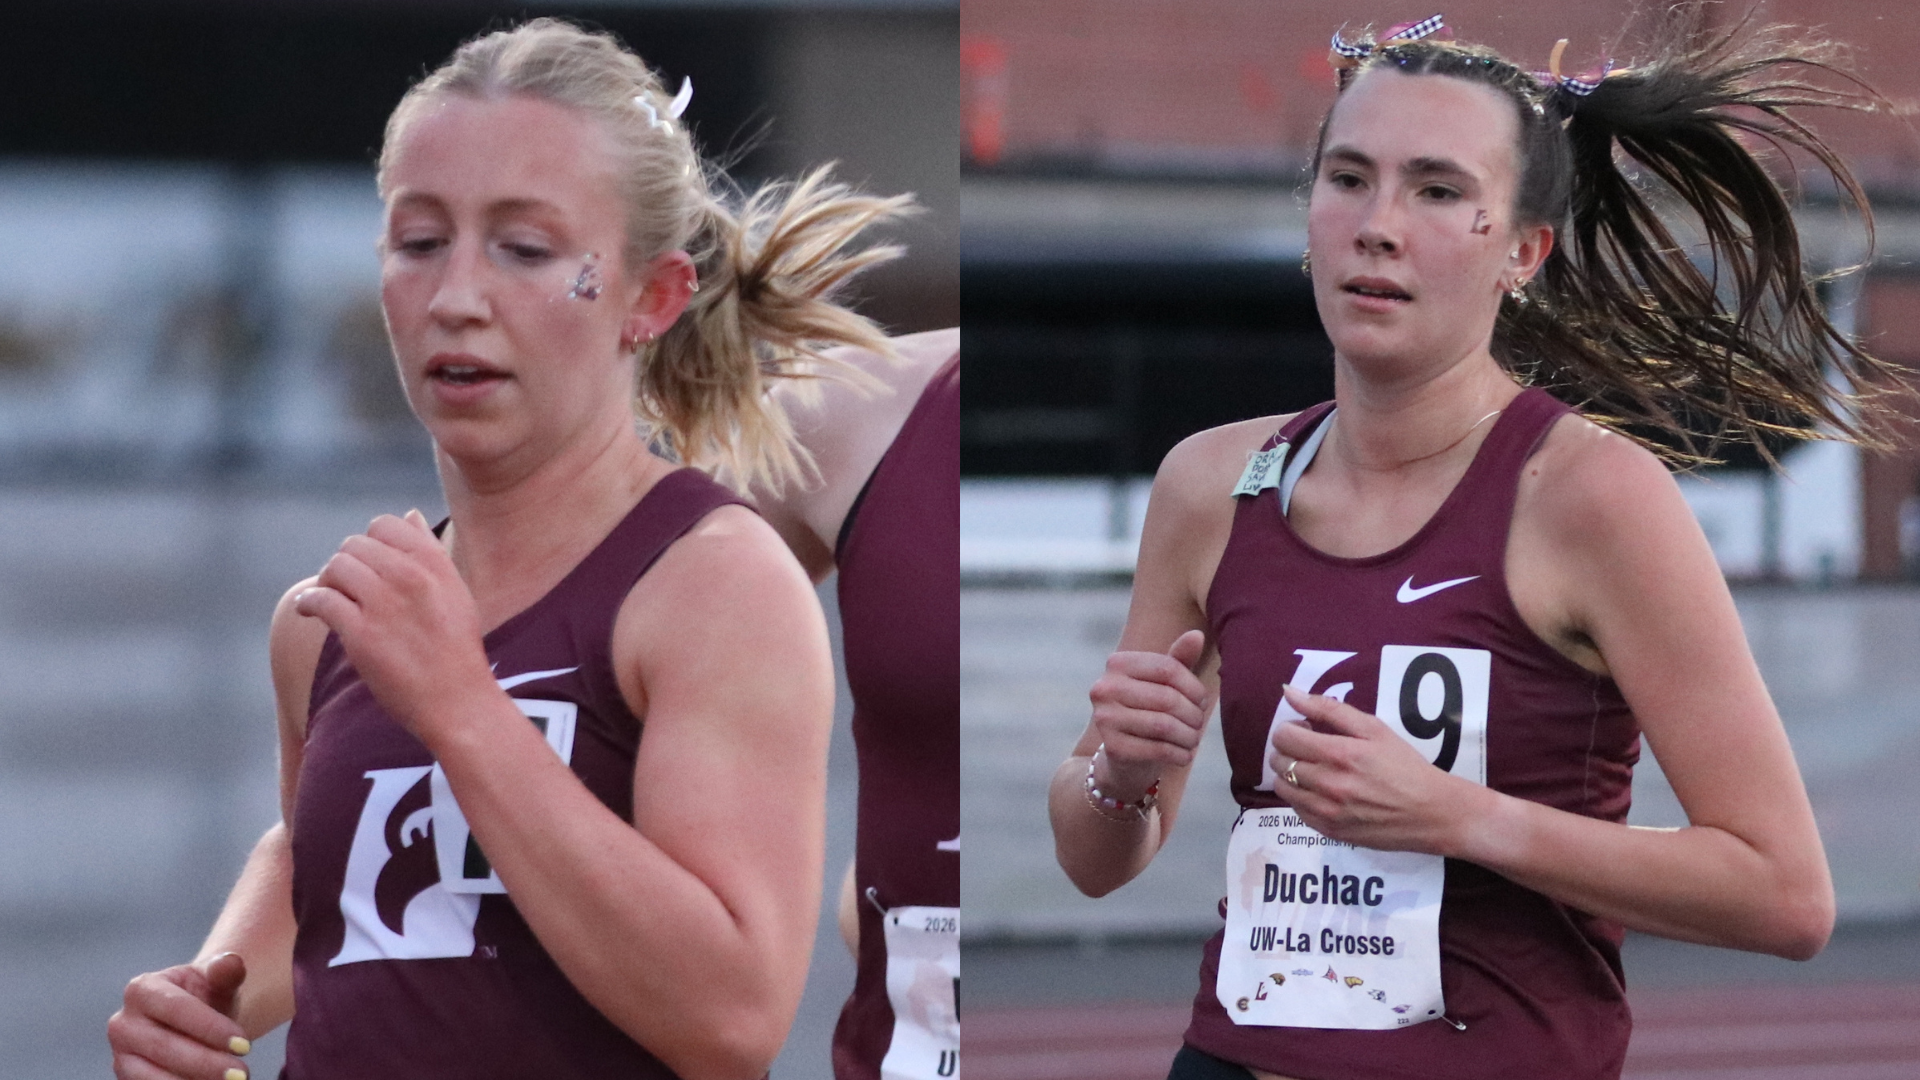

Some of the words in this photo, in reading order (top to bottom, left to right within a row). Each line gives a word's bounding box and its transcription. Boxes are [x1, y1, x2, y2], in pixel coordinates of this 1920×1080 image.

[1399, 652, 1464, 773] 9
[1258, 815, 1280, 827] 2026
[1283, 815, 1309, 827] WIA
[1277, 833, 1358, 850] Champions
[1263, 864, 1385, 906] Duchac
[924, 917, 957, 932] 2026
[1250, 926, 1311, 952] UW-La
[1320, 928, 1395, 955] Crosse
[937, 1050, 960, 1077] U
